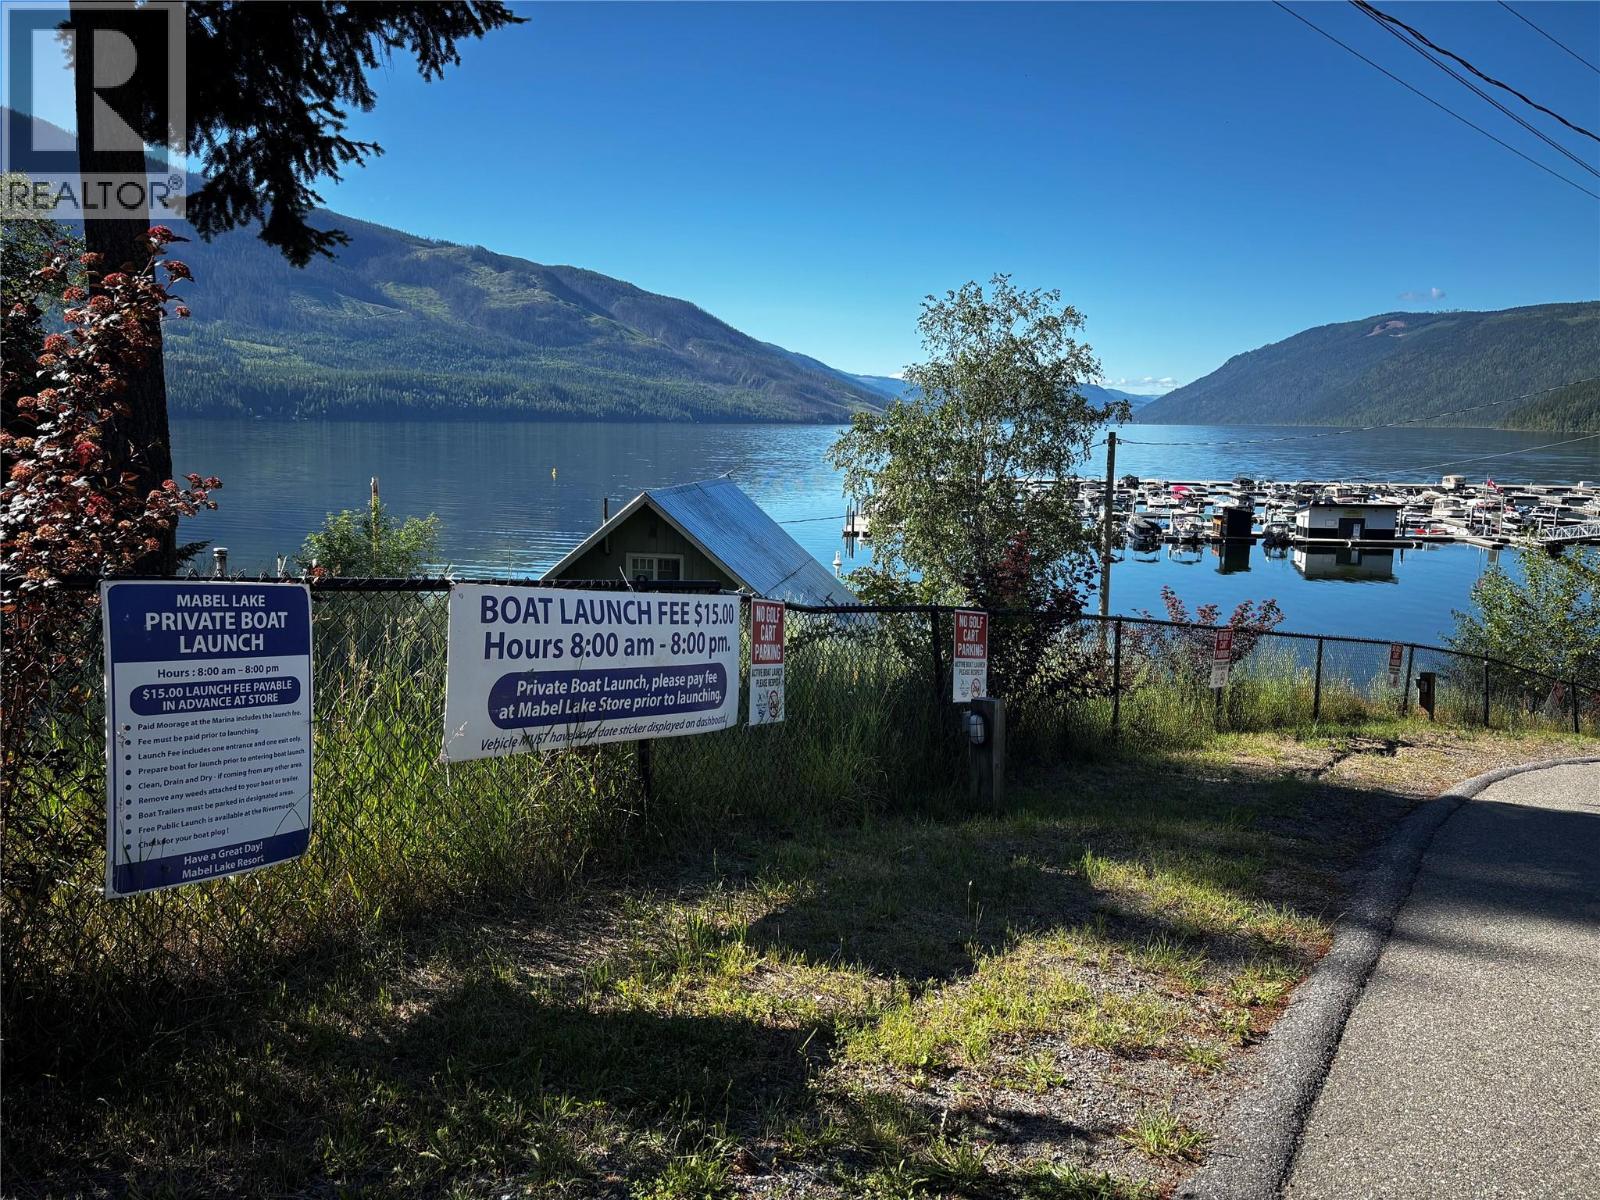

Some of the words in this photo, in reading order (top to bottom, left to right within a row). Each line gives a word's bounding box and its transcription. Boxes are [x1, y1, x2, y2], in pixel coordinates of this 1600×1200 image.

[176, 594, 230, 607] MABEL
[232, 594, 266, 607] LAKE
[145, 612, 236, 631] PRIVATE
[240, 611, 288, 629] BOAT
[480, 595, 553, 625] BOAT
[560, 598, 652, 625] LAUNCH
[658, 600, 690, 625] FEE
[694, 600, 734, 628] $15.00
[756, 605, 765, 622] NO
[766, 606, 780, 623] GOLF
[959, 614, 967, 628] NO
[969, 616, 984, 629] GOLF
[760, 624, 776, 641] CART
[963, 629, 979, 642] CART
[179, 634, 264, 654] LAUNCH
[484, 631, 564, 660] Hours
[570, 632, 618, 659] 8:00
[624, 638, 654, 656] am
[670, 631, 705, 654] 8:00
[708, 635, 730, 658] pm.
[754, 644, 781, 660] PARKING
[957, 643, 984, 657] PARKING
[158, 668, 190, 678] Hours
[197, 667, 219, 676] 8:00
[221, 667, 236, 675] am
[245, 664, 264, 674] 8:00
[266, 665, 280, 674] pm
[142, 687, 184, 700] $15.00
[186, 684, 232, 697] LAUNCH
[234, 682, 251, 694] FEE
[254, 680, 292, 692] PAYABLE
[516, 680, 568, 696] Private
[570, 678, 602, 694] Boat
[604, 674, 649, 692] Launch,
[651, 673, 686, 692] please
[687, 674, 704, 689] pay
[705, 670, 718, 684] fee
[162, 700, 176, 711] IN
[178, 696, 232, 710] ADVANCE
[234, 694, 247, 706] AT
[248, 692, 278, 704] STORE
[499, 704, 515, 720] at
[517, 699, 562, 718] Mabel
[566, 697, 596, 714] Lake
[599, 697, 631, 711] Store
[633, 693, 662, 712] prior
[664, 693, 675, 706] to
[677, 688, 722, 704] launching.
[138, 722, 154, 730] Paid
[236, 714, 262, 722] includes
[184, 734, 200, 742] paid
[202, 732, 218, 740] prior
[481, 736, 518, 751] Vehicle
[549, 731, 573, 743] have
[598, 726, 619, 737] date
[619, 723, 647, 735] sticker
[647, 719, 684, 733] displayed
[685, 720, 694, 728] on
[138, 752, 166, 760] Launch
[182, 746, 211, 756] includes
[226, 742, 253, 750] entrance
[138, 765, 168, 775] Prepare
[199, 758, 222, 768] launch
[223, 758, 239, 766] prior
[248, 752, 273, 762] entering
[138, 782, 162, 790] Clean,
[164, 778, 184, 786] Drain
[185, 776, 199, 784] and
[224, 769, 247, 778] coming
[138, 795, 169, 804] Remove
[185, 788, 207, 798] weeds
[208, 784, 237, 794] attached
[138, 811, 156, 819] Boat
[158, 808, 184, 816] Trailers
[186, 804, 204, 812] must
[215, 798, 238, 808] parked
[246, 792, 278, 802] designated
[157, 822, 180, 831] Public
[181, 817, 207, 827] Launch
[215, 811, 244, 821] available
[138, 838, 162, 848] Chek
[176, 835, 192, 844] your
[194, 832, 209, 840] boat
[183, 854, 209, 865] Have
[218, 846, 243, 858] Great
[244, 842, 263, 854] Day!
[182, 864, 212, 879] Mabel
[215, 860, 236, 872] Lake
[237, 854, 264, 867] Resort
